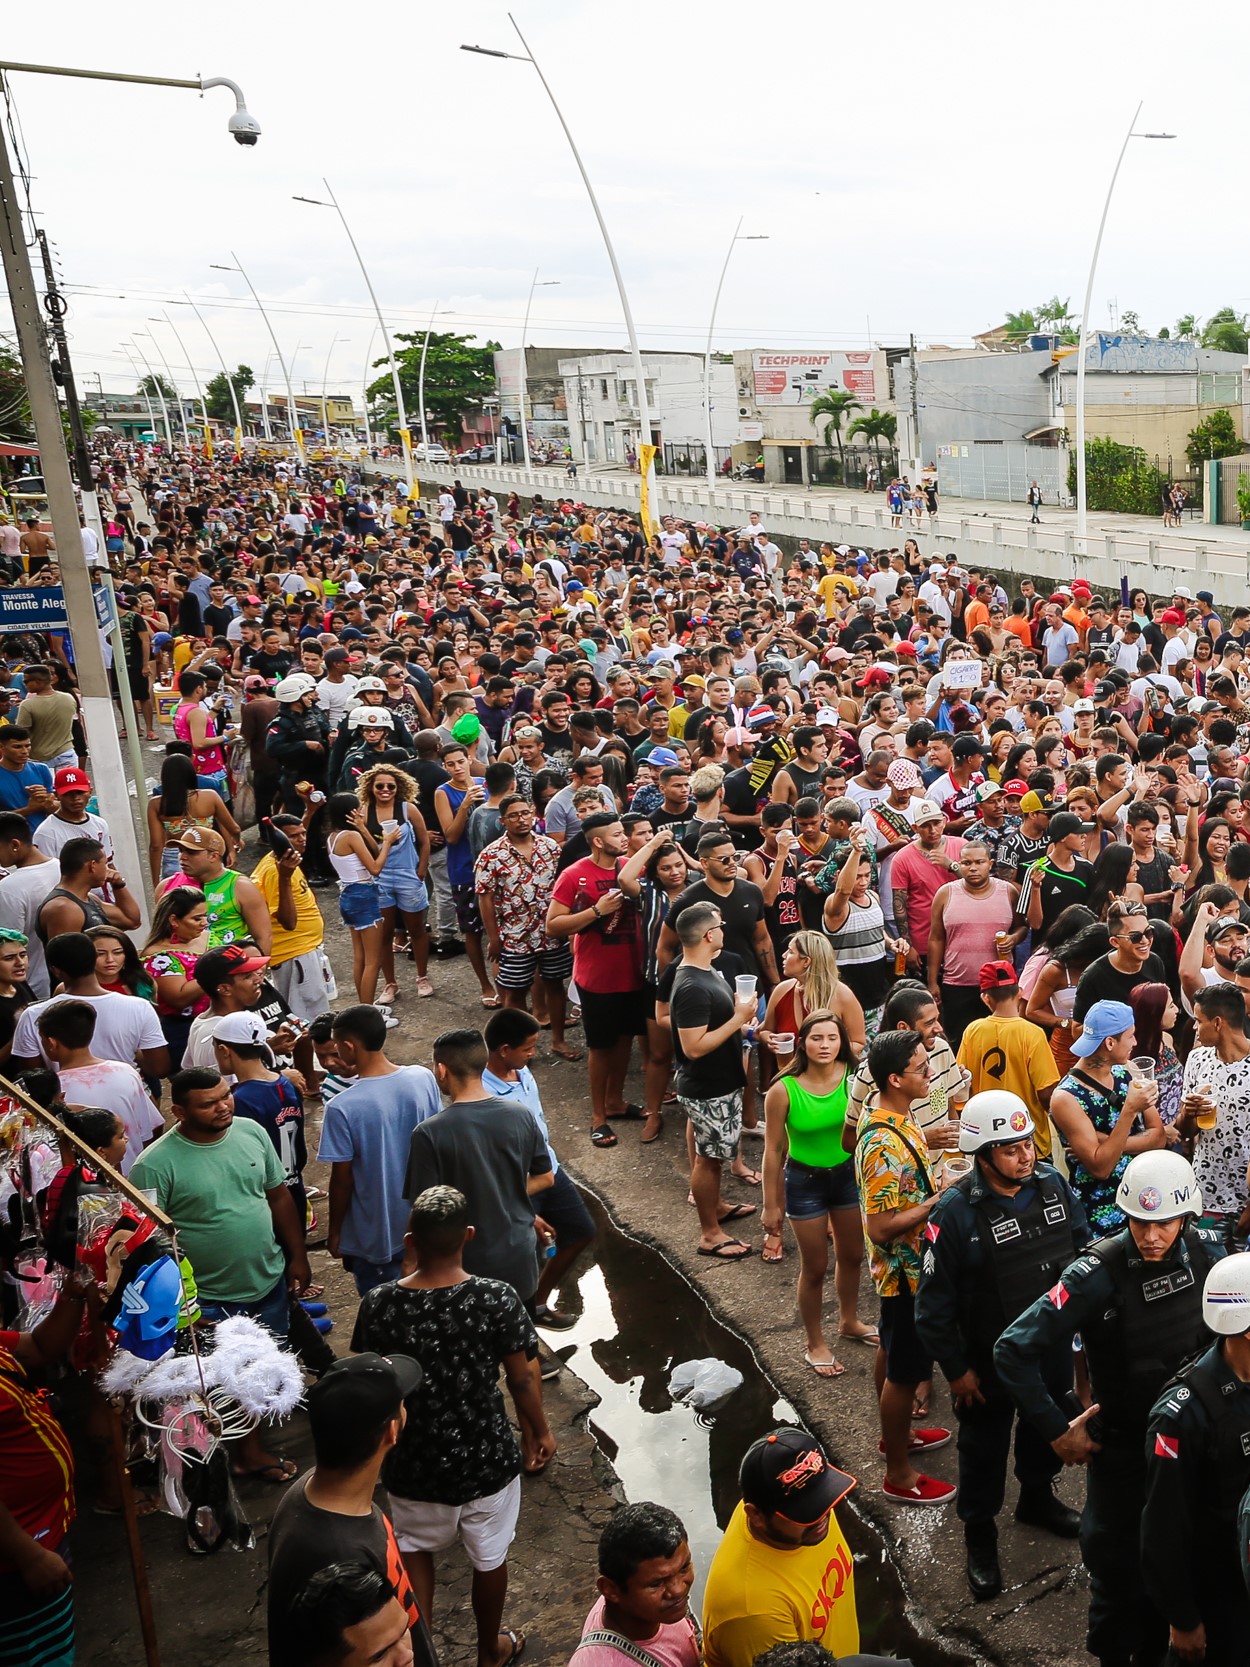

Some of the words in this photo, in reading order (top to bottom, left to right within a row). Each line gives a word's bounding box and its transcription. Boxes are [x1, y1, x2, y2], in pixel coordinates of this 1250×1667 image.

[758, 356, 830, 366] TECHPRINT
[1, 593, 35, 601] TRAVESSA
[3, 600, 39, 611] Monte
[42, 598, 67, 610] Aleg
[1008, 782, 1021, 790] NYC
[779, 900, 800, 925] 23
[992, 1117, 1007, 1131] P
[1173, 1185, 1190, 1205] M
[810, 1543, 853, 1641] SKOL
